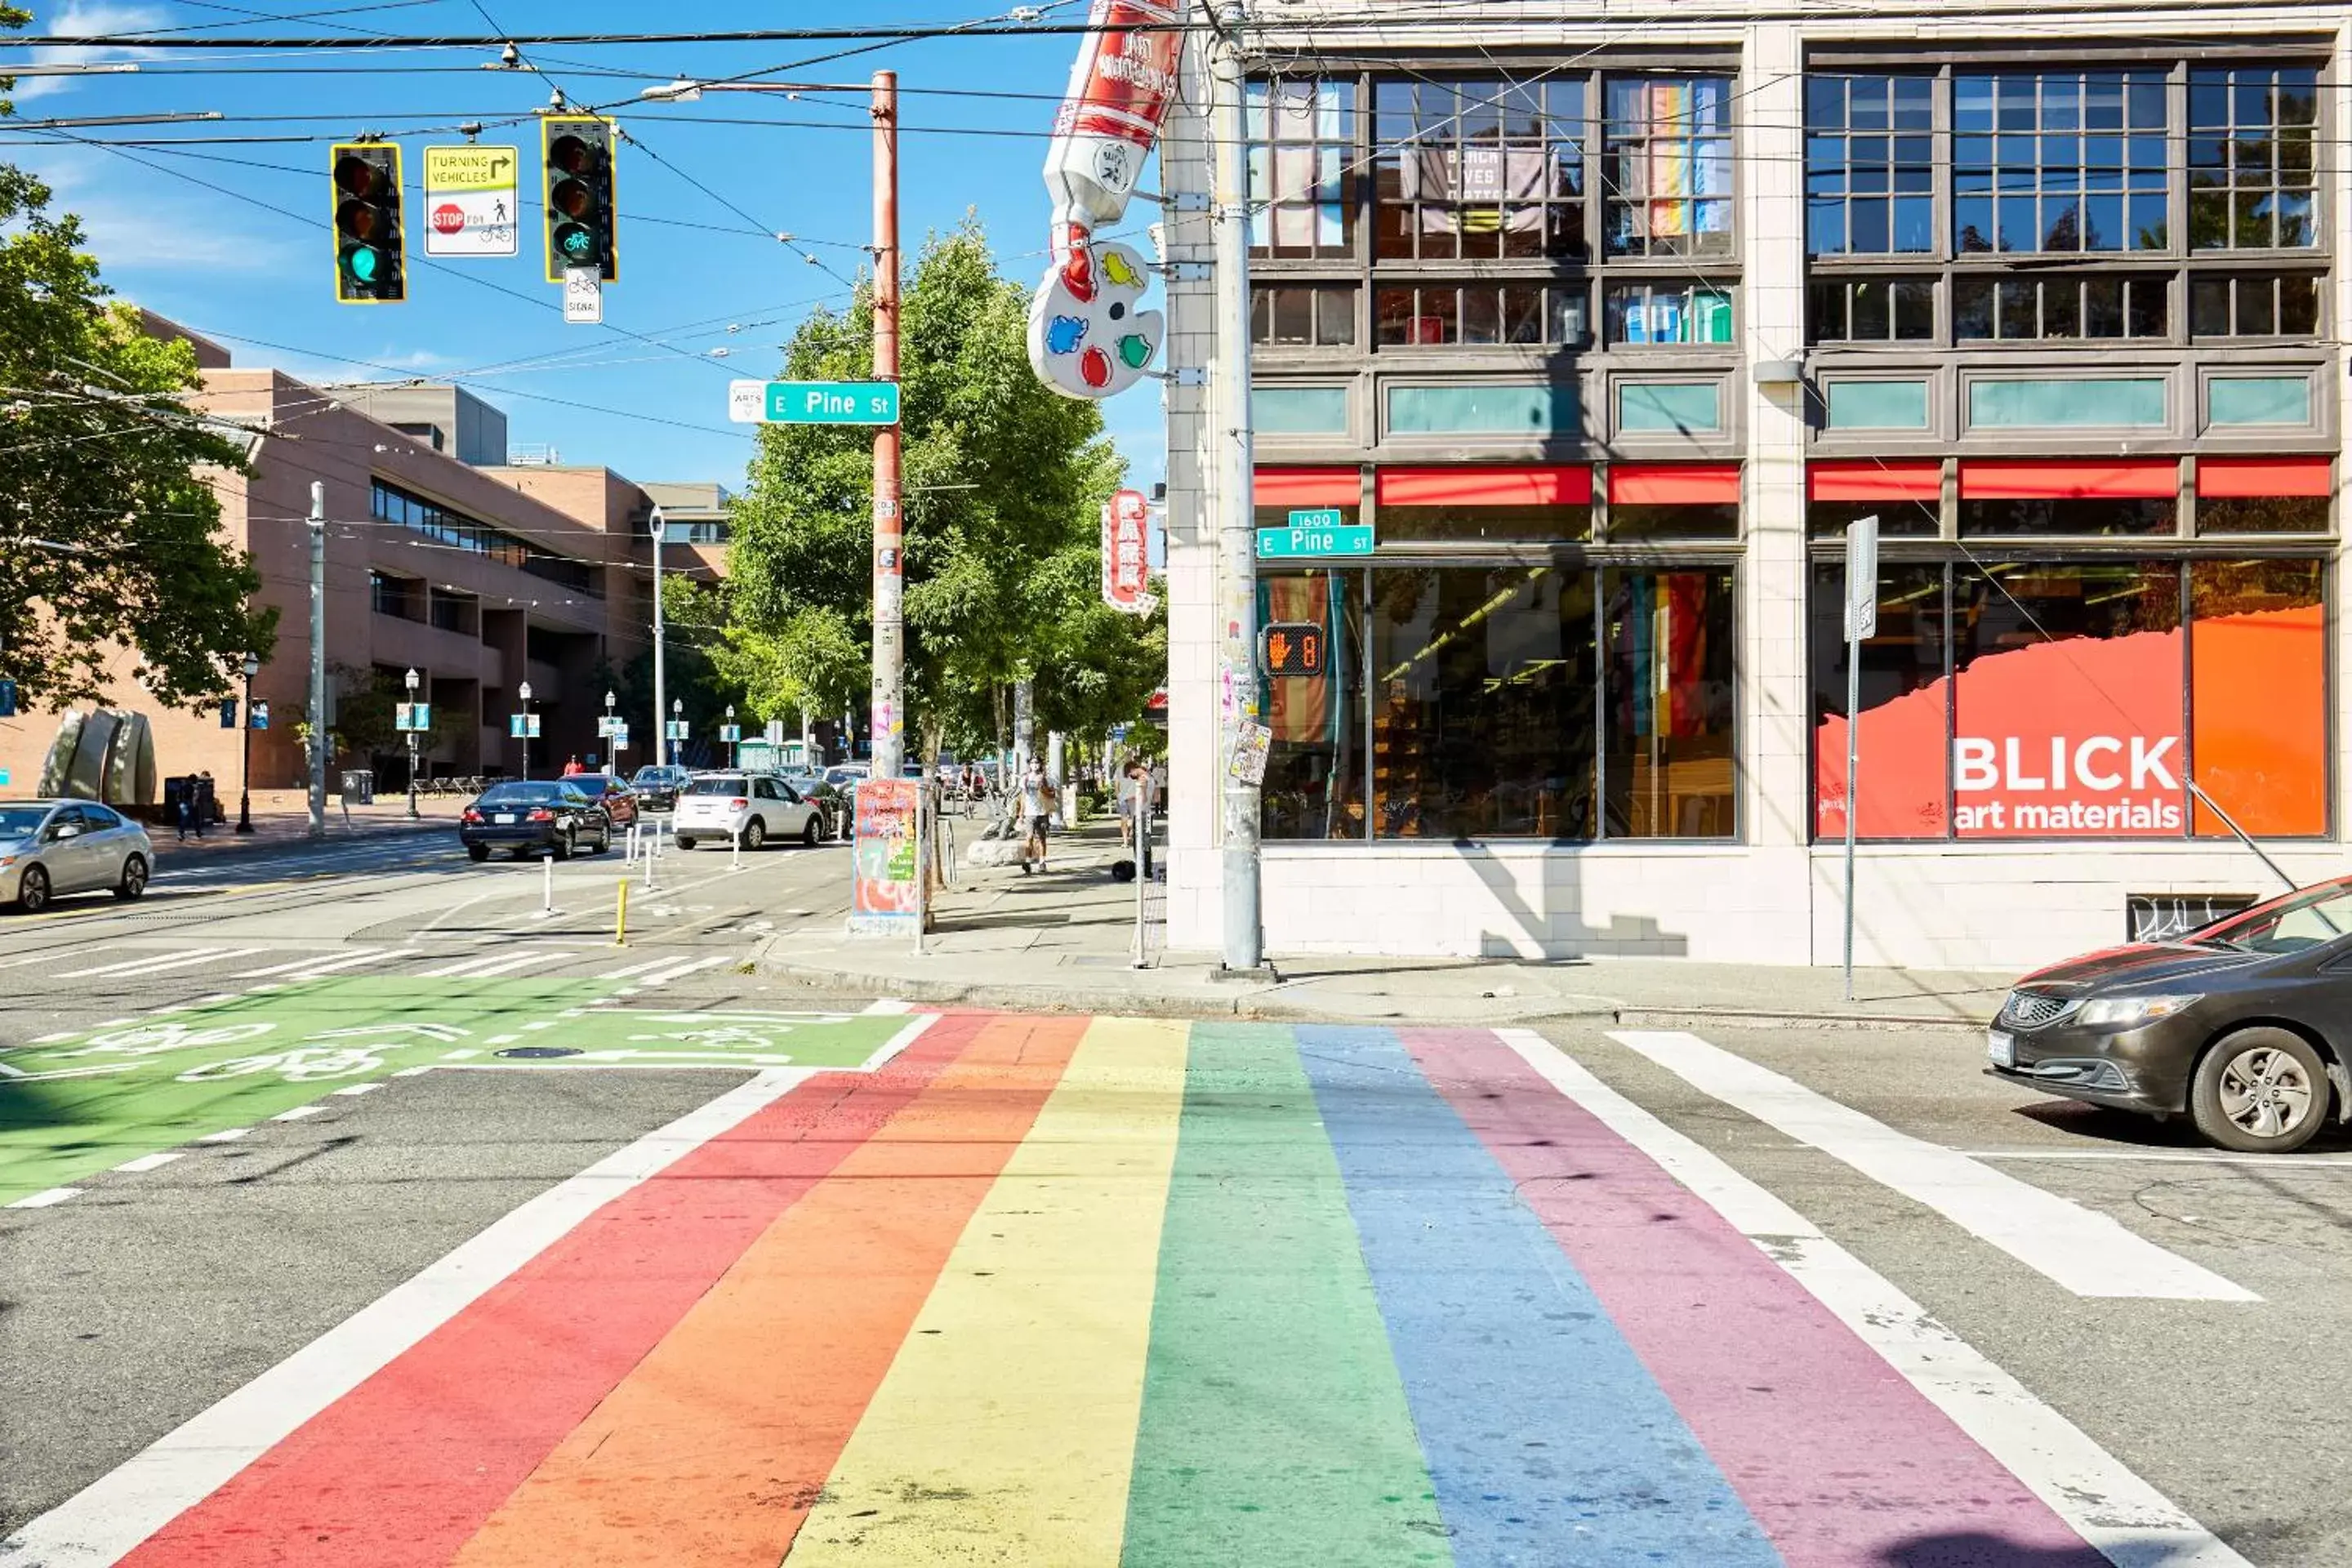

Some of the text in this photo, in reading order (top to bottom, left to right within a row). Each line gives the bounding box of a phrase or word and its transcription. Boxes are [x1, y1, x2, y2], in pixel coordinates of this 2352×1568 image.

[432, 156, 489, 167] TURNING
[432, 172, 488, 183] VEHICLES
[1447, 169, 1494, 184] LVES
[433, 212, 463, 226] STOP
[568, 301, 595, 312] SIGNAL
[776, 391, 889, 414] E Pine St
[1298, 514, 1331, 526] 1600
[1263, 529, 1367, 552] E Pine ST
[1953, 736, 2180, 791] BLICK
[1953, 800, 2006, 829] art
[2014, 797, 2180, 829] materials
